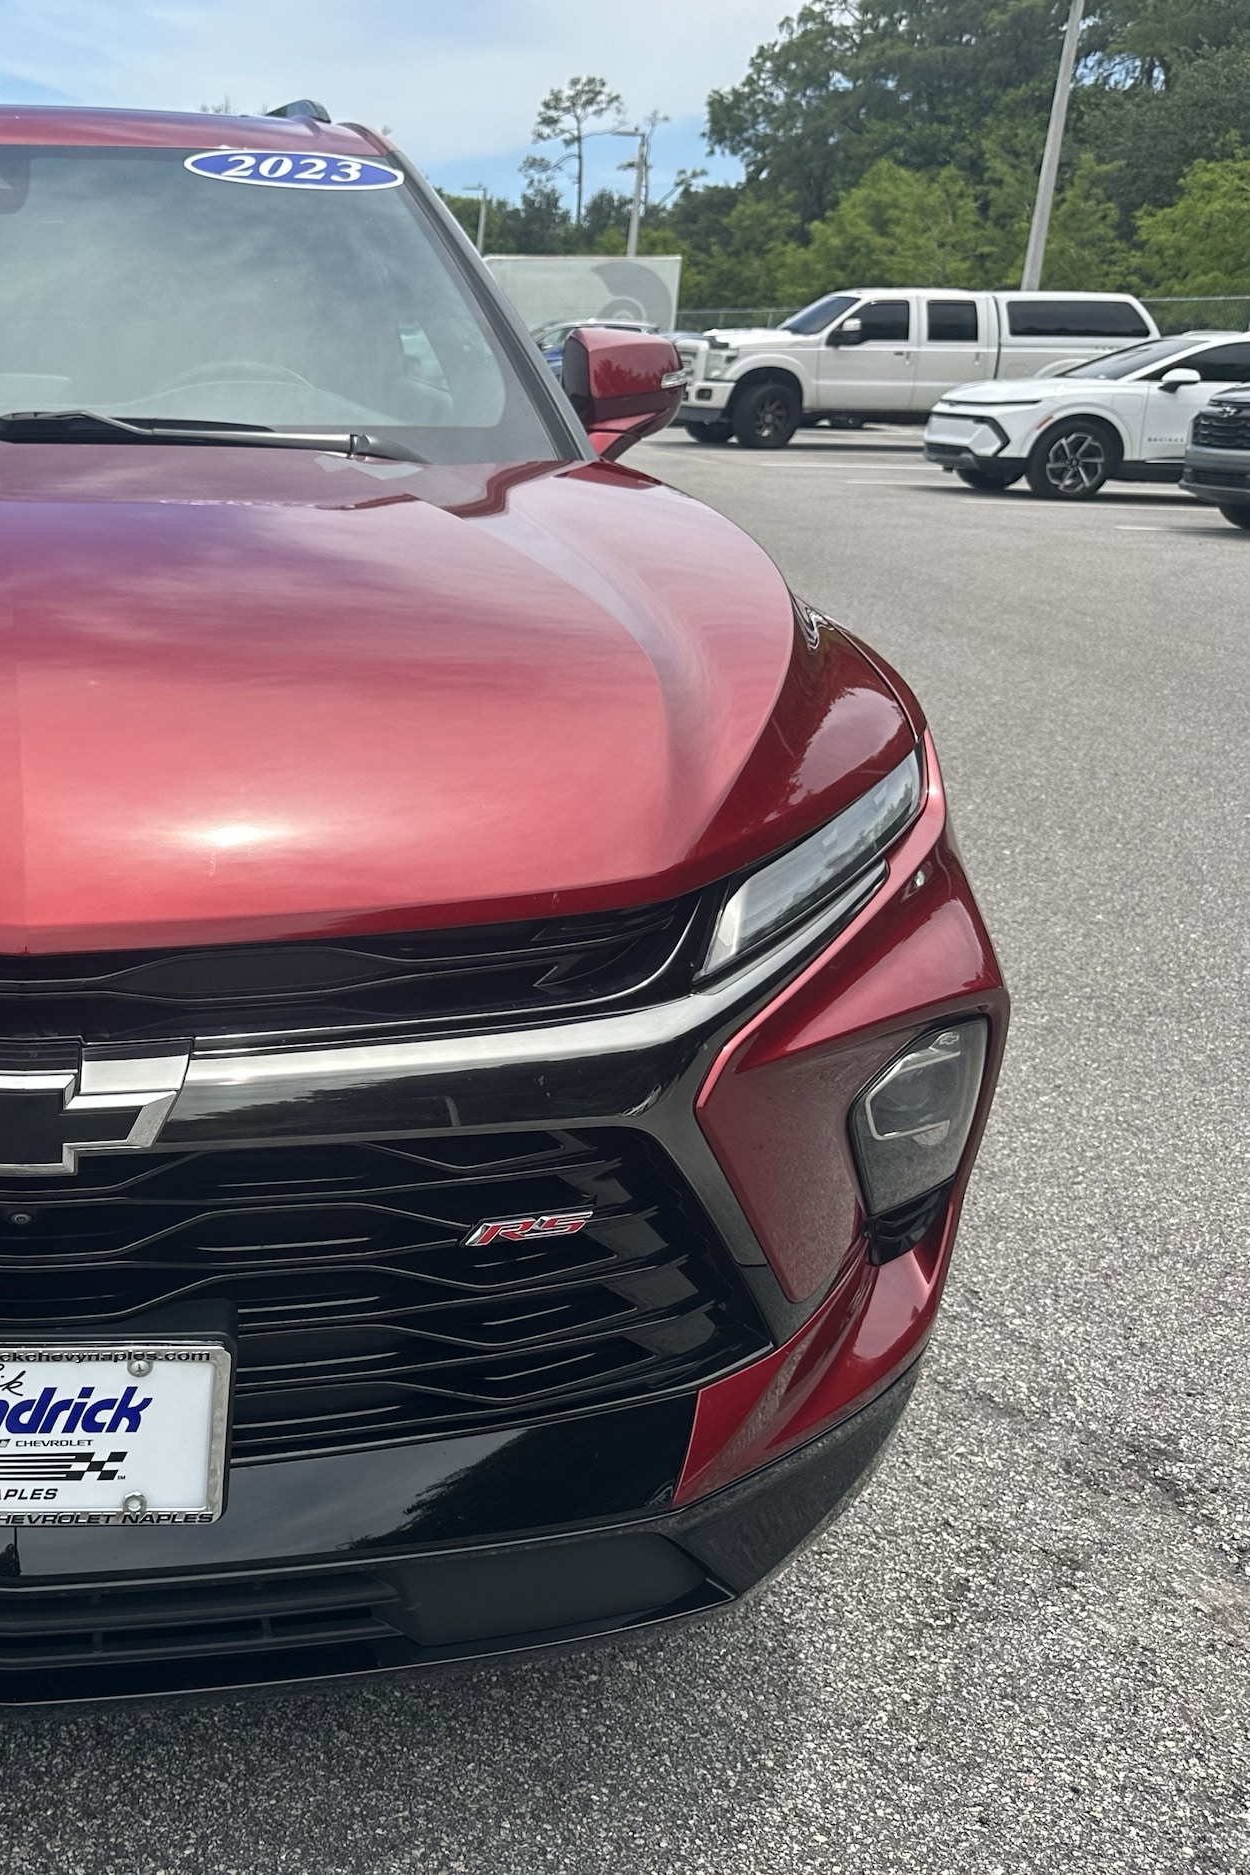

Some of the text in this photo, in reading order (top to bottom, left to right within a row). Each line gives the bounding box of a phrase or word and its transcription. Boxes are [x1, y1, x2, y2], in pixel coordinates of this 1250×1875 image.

[221, 155, 362, 182] 2023
[464, 1211, 594, 1246] RS
[15, 1439, 94, 1448] CHEVROLET
[121, 1511, 214, 1525] NAPLES
